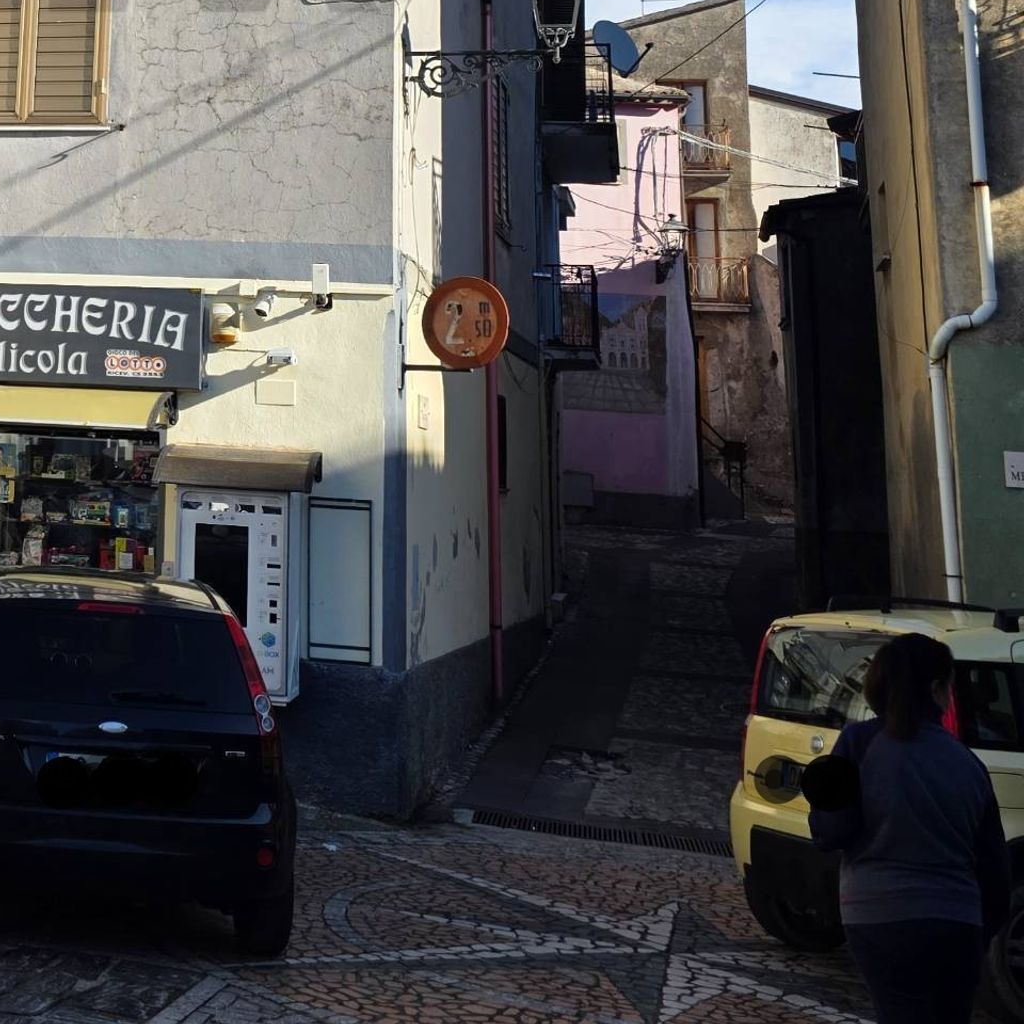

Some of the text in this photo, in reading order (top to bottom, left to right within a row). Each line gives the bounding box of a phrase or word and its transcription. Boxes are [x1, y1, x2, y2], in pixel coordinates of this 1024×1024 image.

[445, 301, 465, 345] 2
[475, 319, 492, 338] 50
[108, 357, 164, 370] LOTTO
